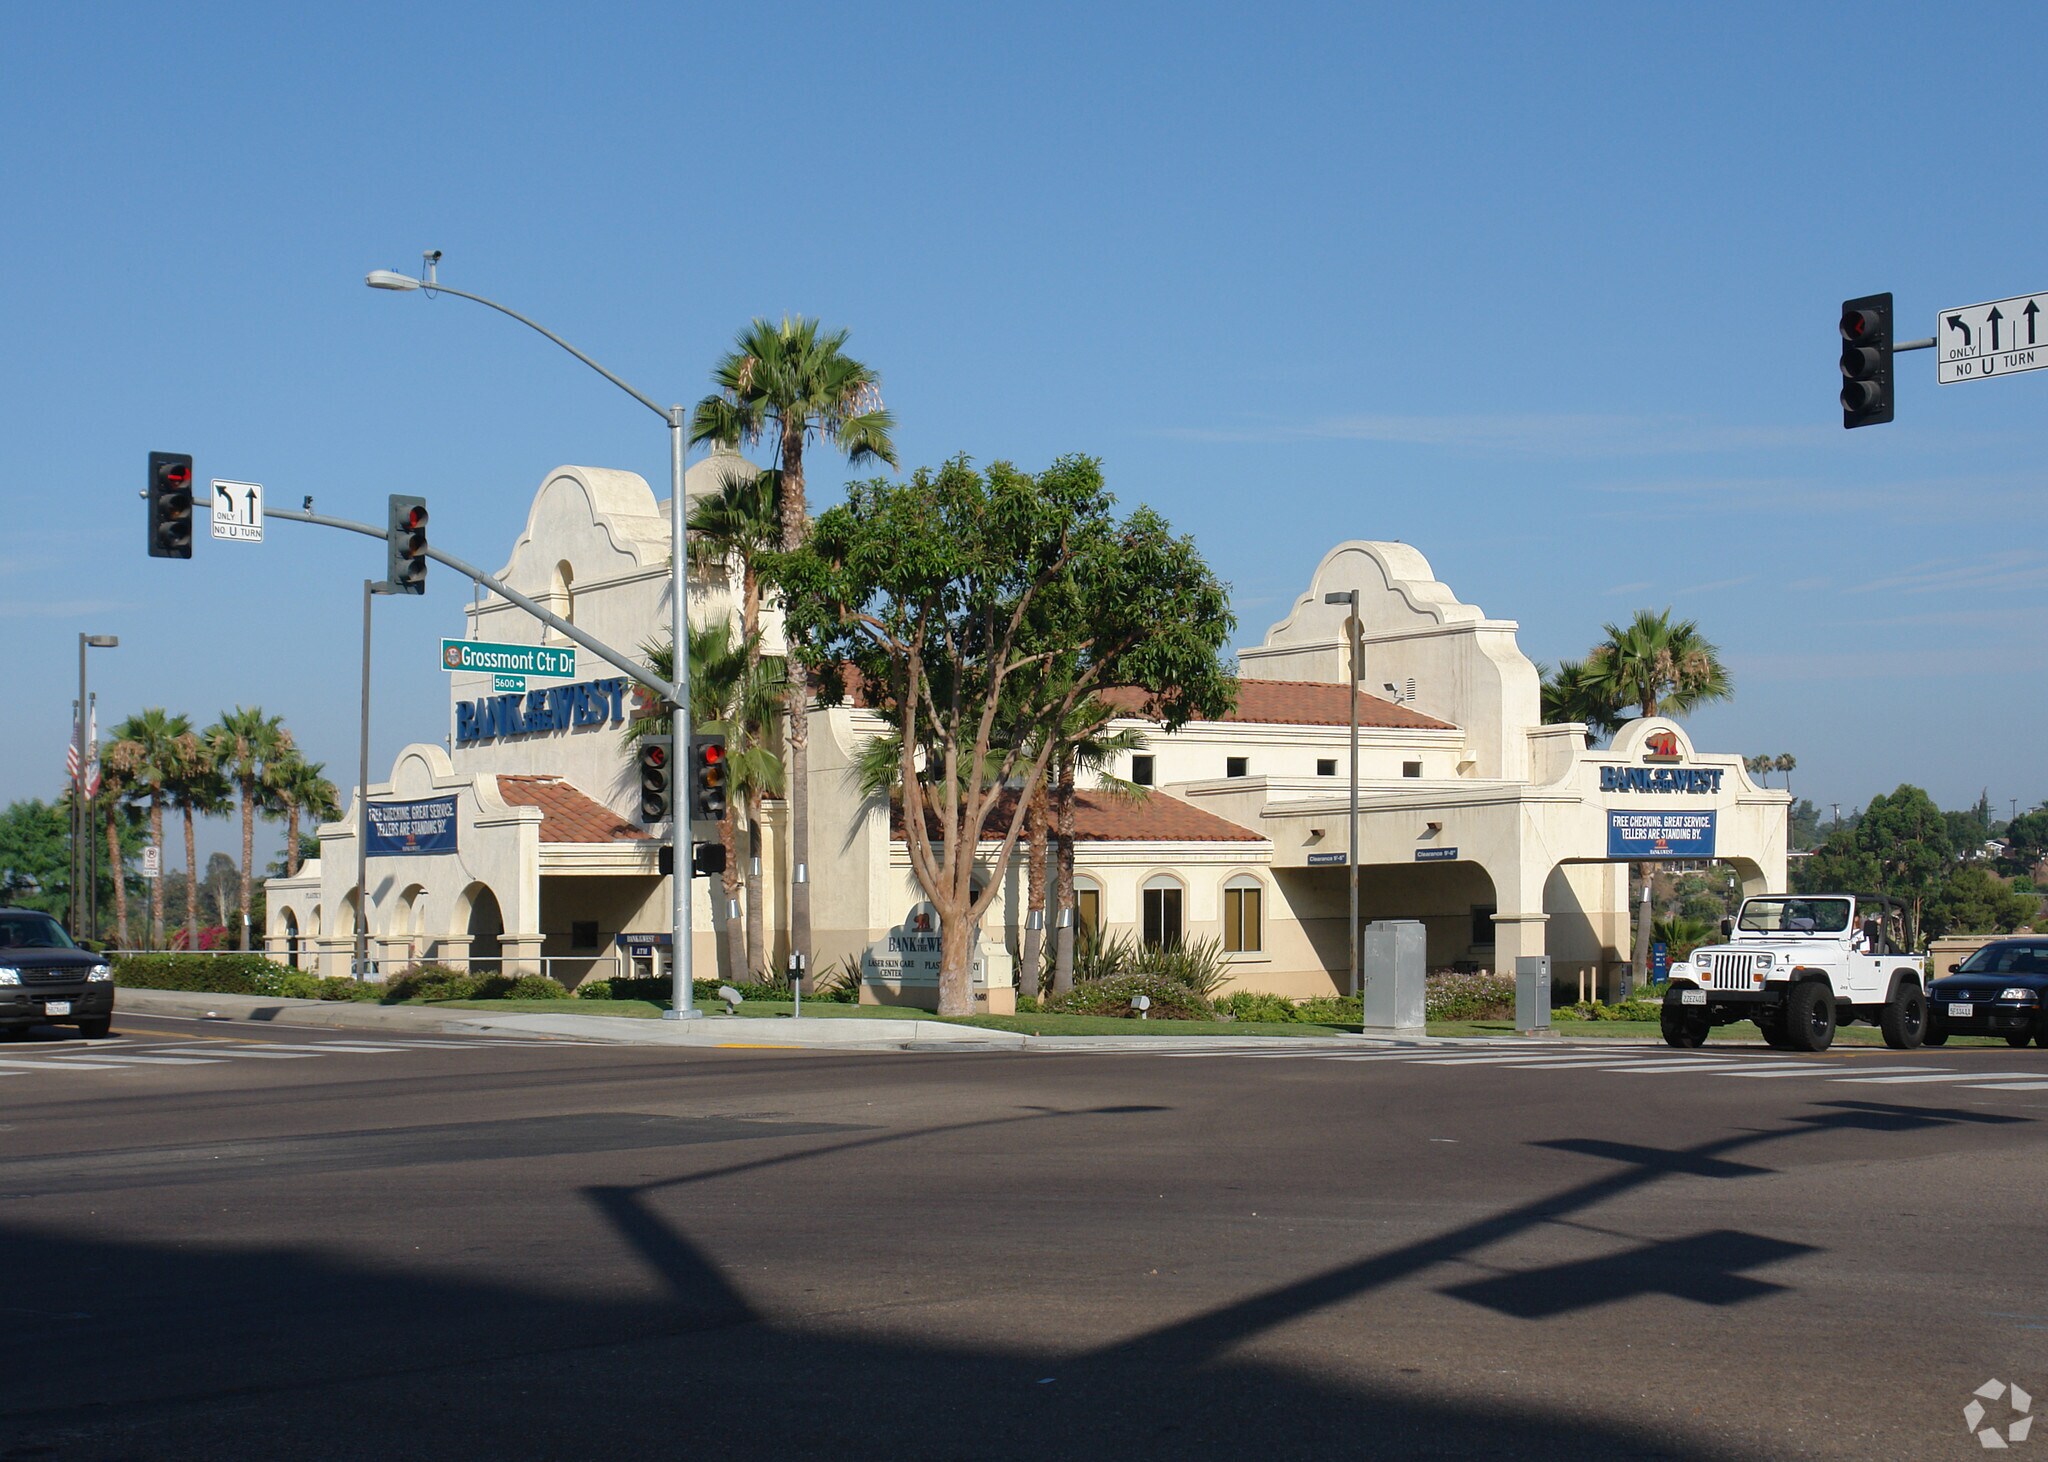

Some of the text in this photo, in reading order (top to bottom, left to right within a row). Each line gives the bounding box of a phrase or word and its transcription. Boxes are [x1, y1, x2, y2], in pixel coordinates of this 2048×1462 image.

[1949, 346, 1976, 359] ONLY
[1956, 351, 2034, 376] NO U TURN
[217, 512, 235, 520] ONLY
[214, 526, 261, 537] NO U TURN
[461, 646, 574, 673] Grossmont Ctr Dr
[495, 679, 514, 688] 5600
[455, 694, 524, 741] BANK
[547, 676, 628, 732] WEST
[1600, 766, 1655, 792] BANK
[1671, 769, 1724, 793] WEST
[411, 804, 428, 820] GREAT
[1613, 816, 1711, 828] FREE CHECKING. GREAT SERVICE.
[400, 821, 410, 836] ARE
[1622, 829, 1701, 839] TELLERS ARE STANDING BY.
[888, 937, 917, 952] BANK
[928, 937, 942, 952] WE
[868, 959, 915, 968] LASER SKIN CARE
[924, 961, 940, 970] PLAS
[880, 969, 902, 977] CENTER
